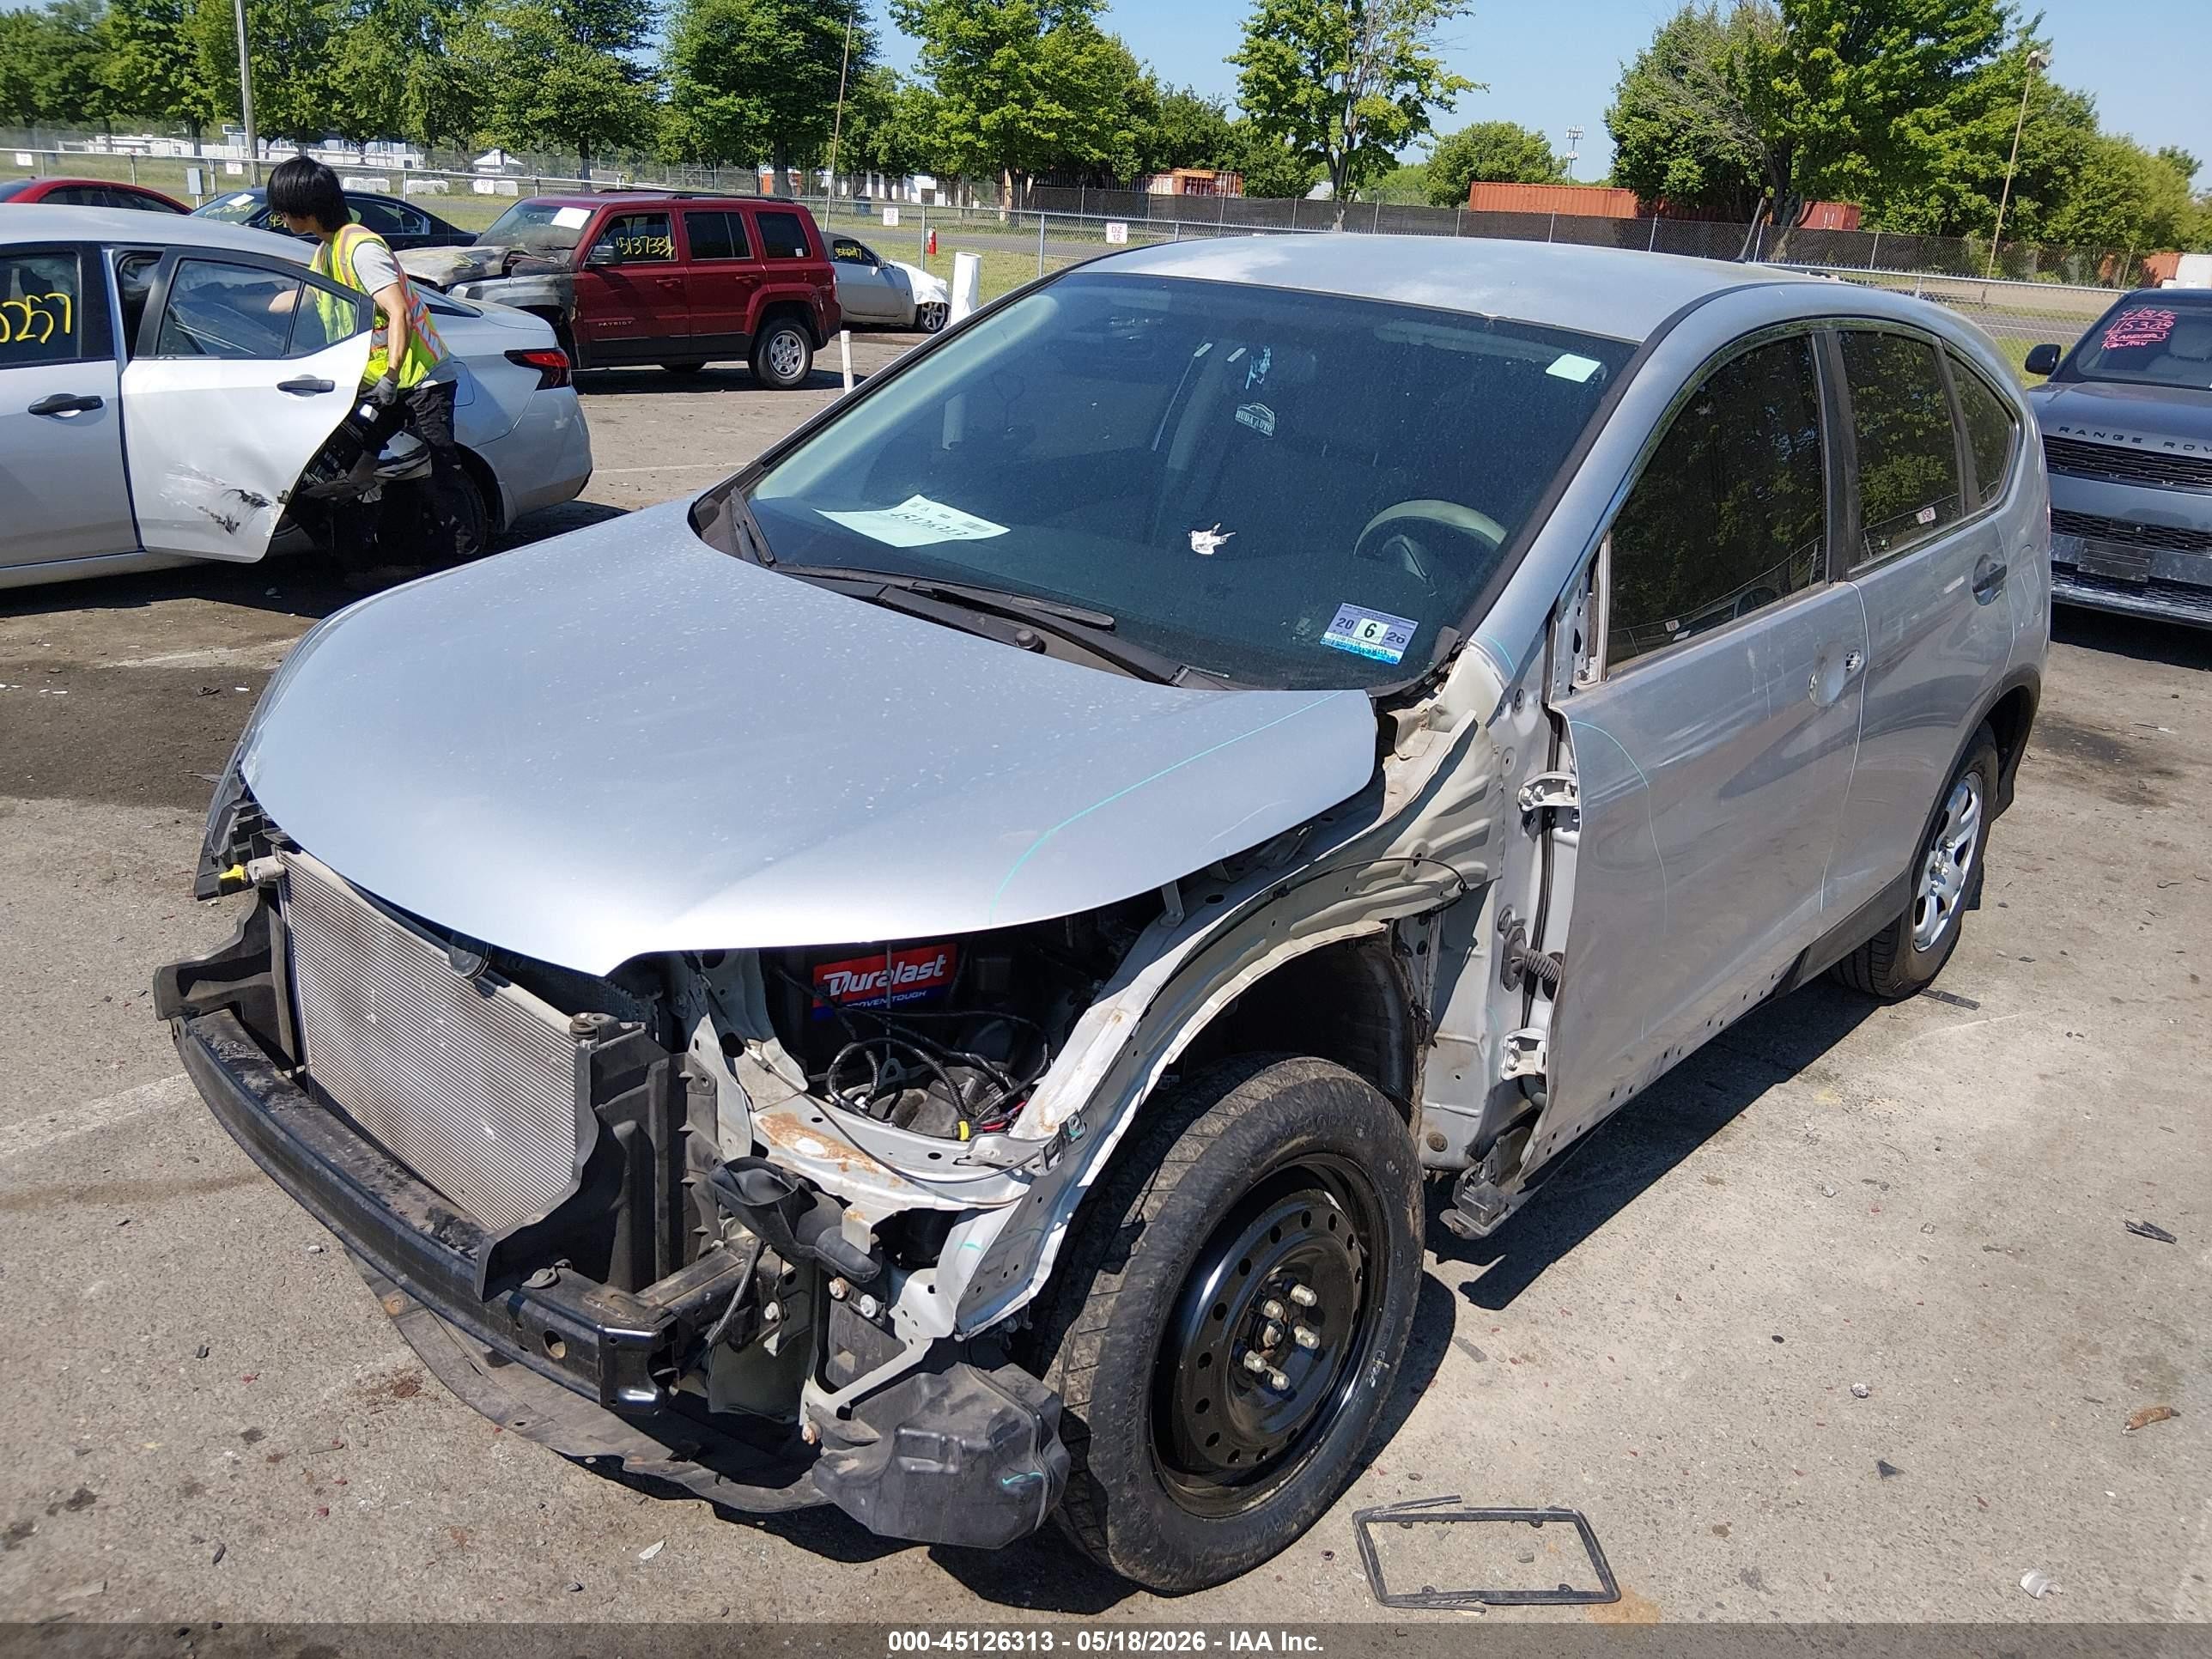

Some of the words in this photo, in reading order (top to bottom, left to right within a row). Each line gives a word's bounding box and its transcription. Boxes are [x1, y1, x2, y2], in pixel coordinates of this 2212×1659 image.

[2058, 426, 2143, 444] RANGE
[1335, 617, 1355, 630] 20
[1364, 623, 1377, 638] 6
[823, 954, 947, 996] Duralast
[891, 990, 927, 1002] TOUGH
